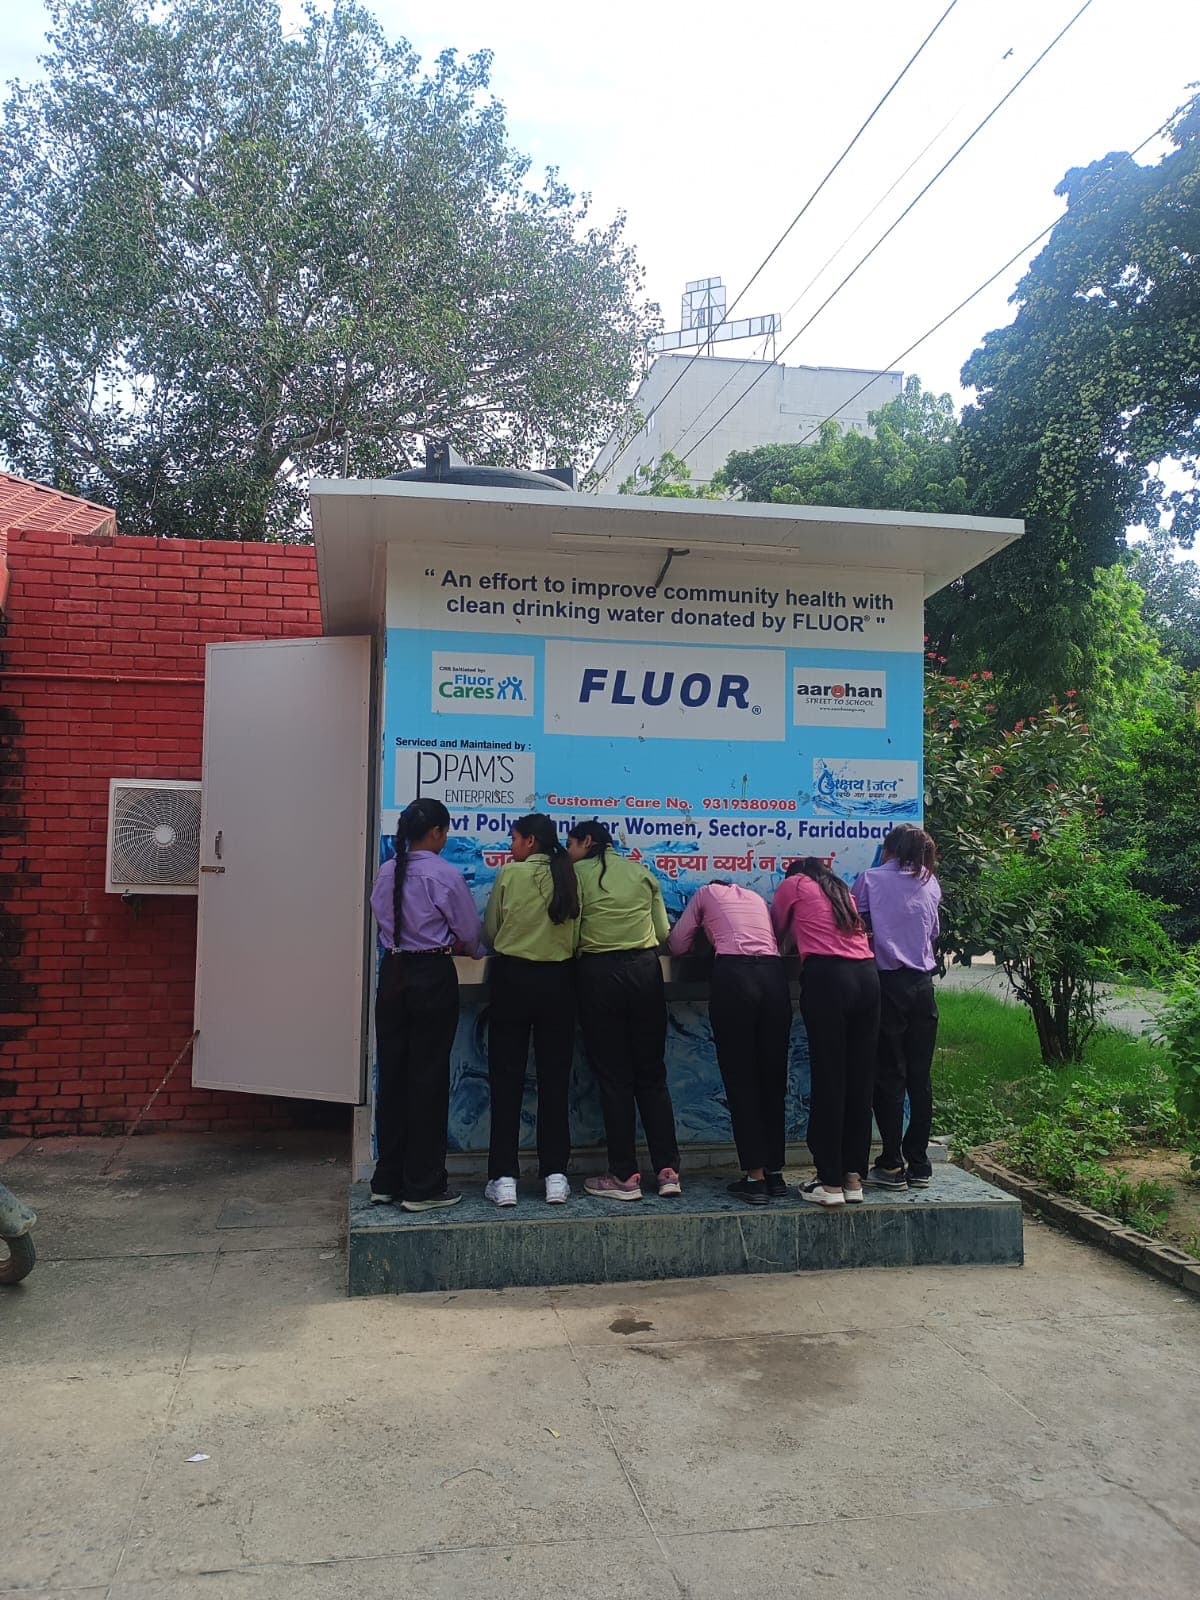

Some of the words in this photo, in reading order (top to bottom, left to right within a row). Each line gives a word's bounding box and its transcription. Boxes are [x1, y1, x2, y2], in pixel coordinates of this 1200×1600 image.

[441, 569, 472, 588] An
[479, 572, 537, 592] effort
[544, 575, 565, 593] to
[572, 578, 657, 600] improve
[663, 584, 779, 609] community
[786, 588, 846, 608] health
[853, 592, 894, 610] with
[446, 596, 505, 614] clean
[512, 599, 600, 624] drinking
[607, 606, 664, 624] water
[671, 608, 755, 628] donated
[762, 612, 786, 633] by
[454, 674, 494, 686] Fluor
[438, 681, 495, 699] Cares
[797, 683, 882, 699] aarohan
[805, 697, 832, 705] STREET
[395, 737, 437, 748] Serviced
[439, 738, 458, 748] and
[460, 739, 512, 750] Maintained
[514, 741, 526, 752] by
[445, 789, 514, 805] ENTERPRISES
[546, 794, 621, 808] Customer
[625, 796, 663, 809] Care
[666, 797, 693, 810] No.
[703, 798, 797, 811] 9319380908
[625, 817, 703, 838] Women,
[708, 818, 793, 839] Sector-8,
[713, 849, 754, 872] व्यर्थ
[759, 856, 776, 872] न
